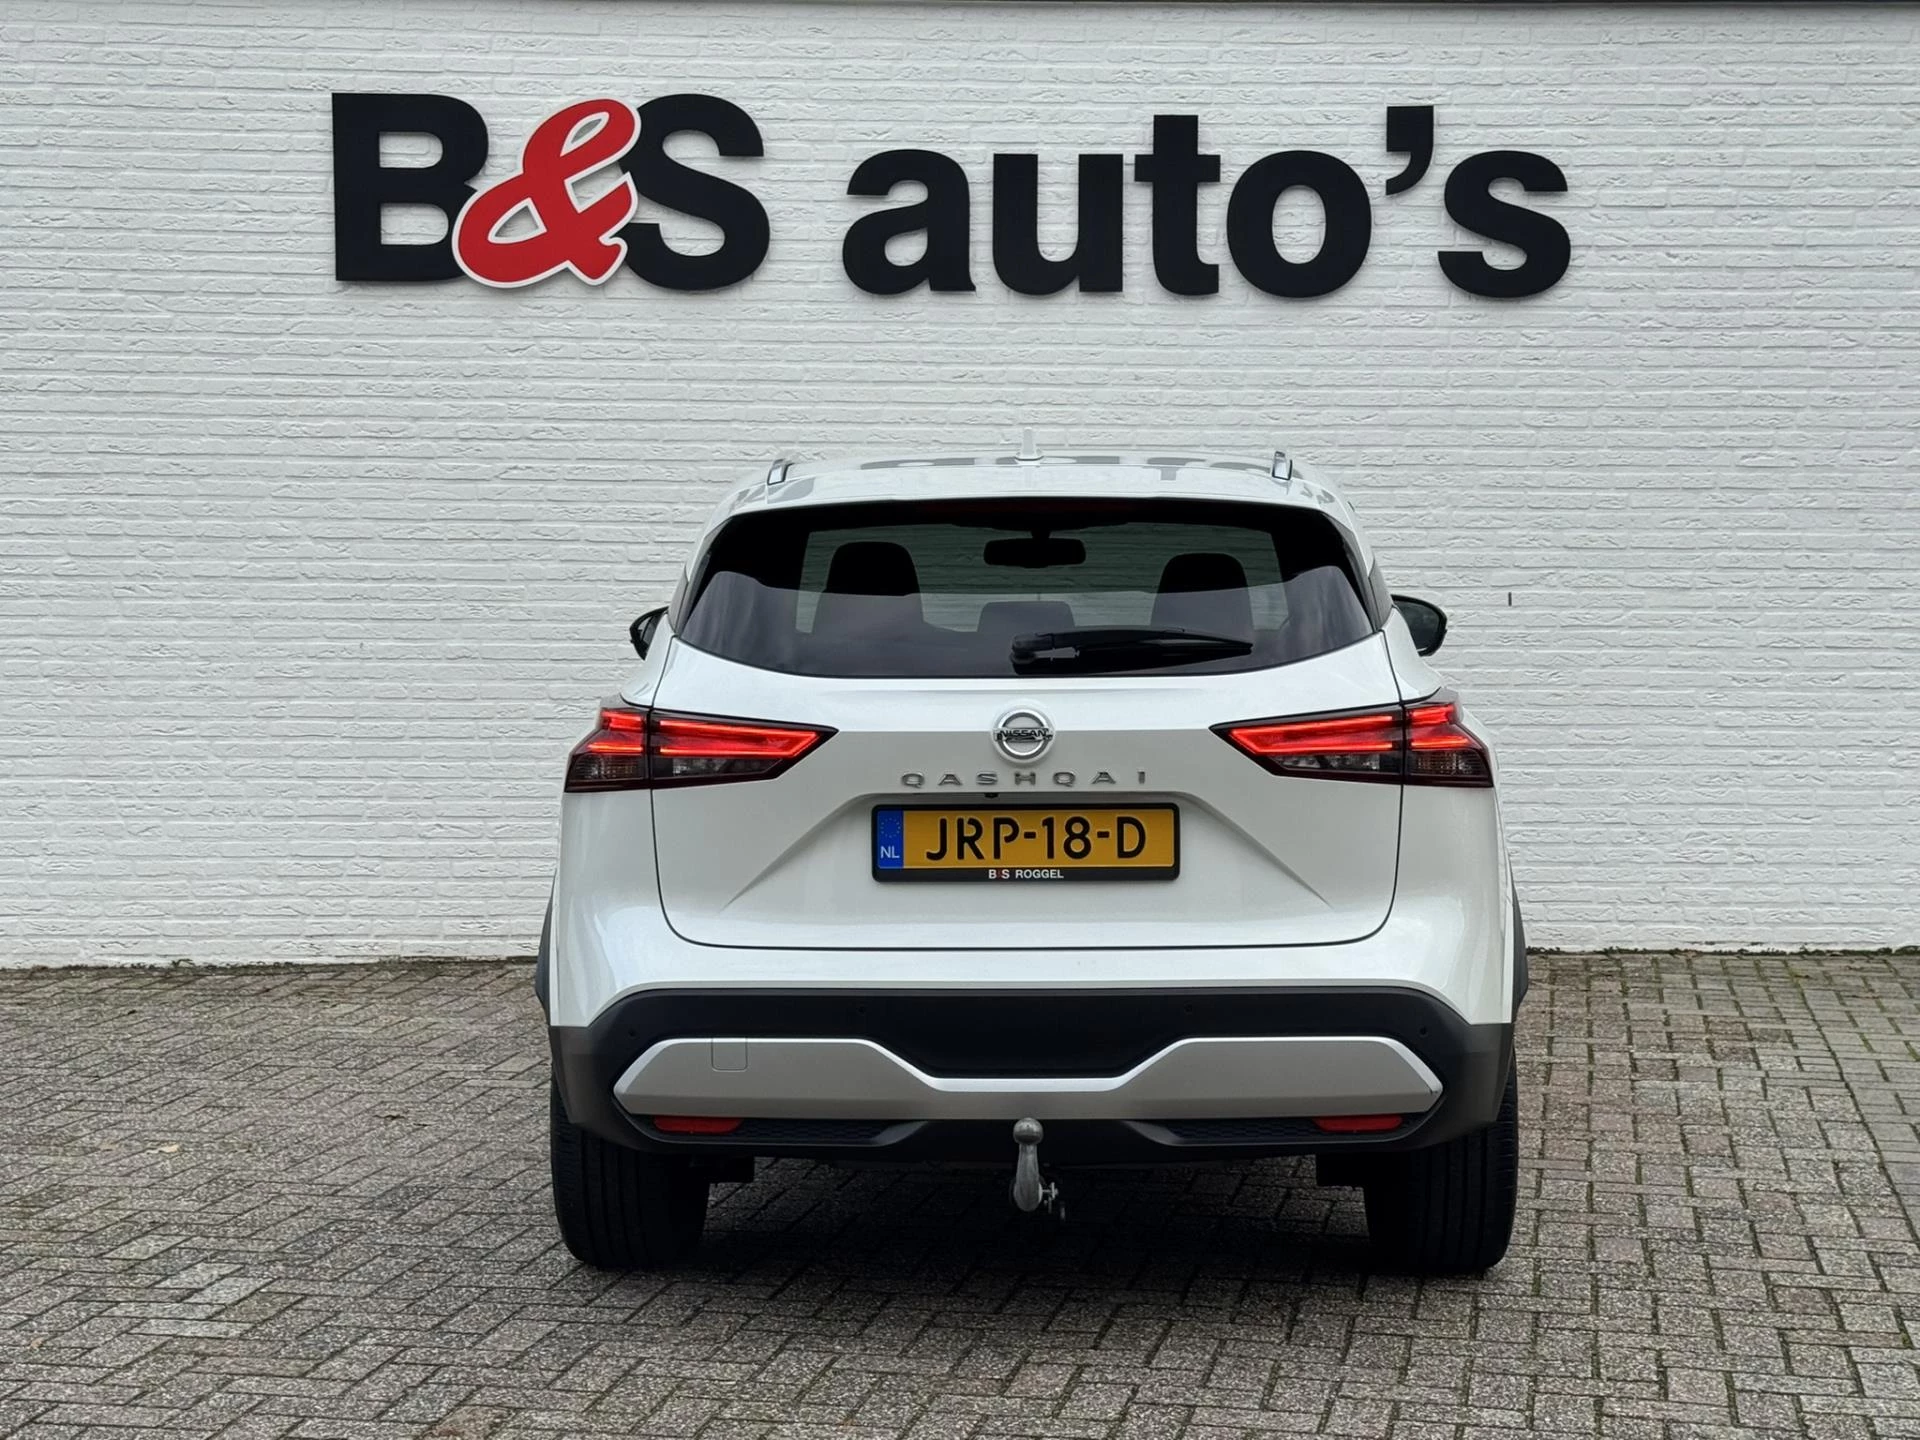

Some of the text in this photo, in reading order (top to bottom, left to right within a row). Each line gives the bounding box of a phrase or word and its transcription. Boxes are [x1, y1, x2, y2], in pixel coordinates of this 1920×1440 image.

[332, 92, 1572, 298] B&S auto's
[998, 728, 1048, 739] NISSAN
[901, 771, 1146, 789] QASHQAI
[925, 816, 1146, 861] JRP-18-D
[880, 846, 900, 859] NL
[1015, 868, 1064, 880] ROGGEL
